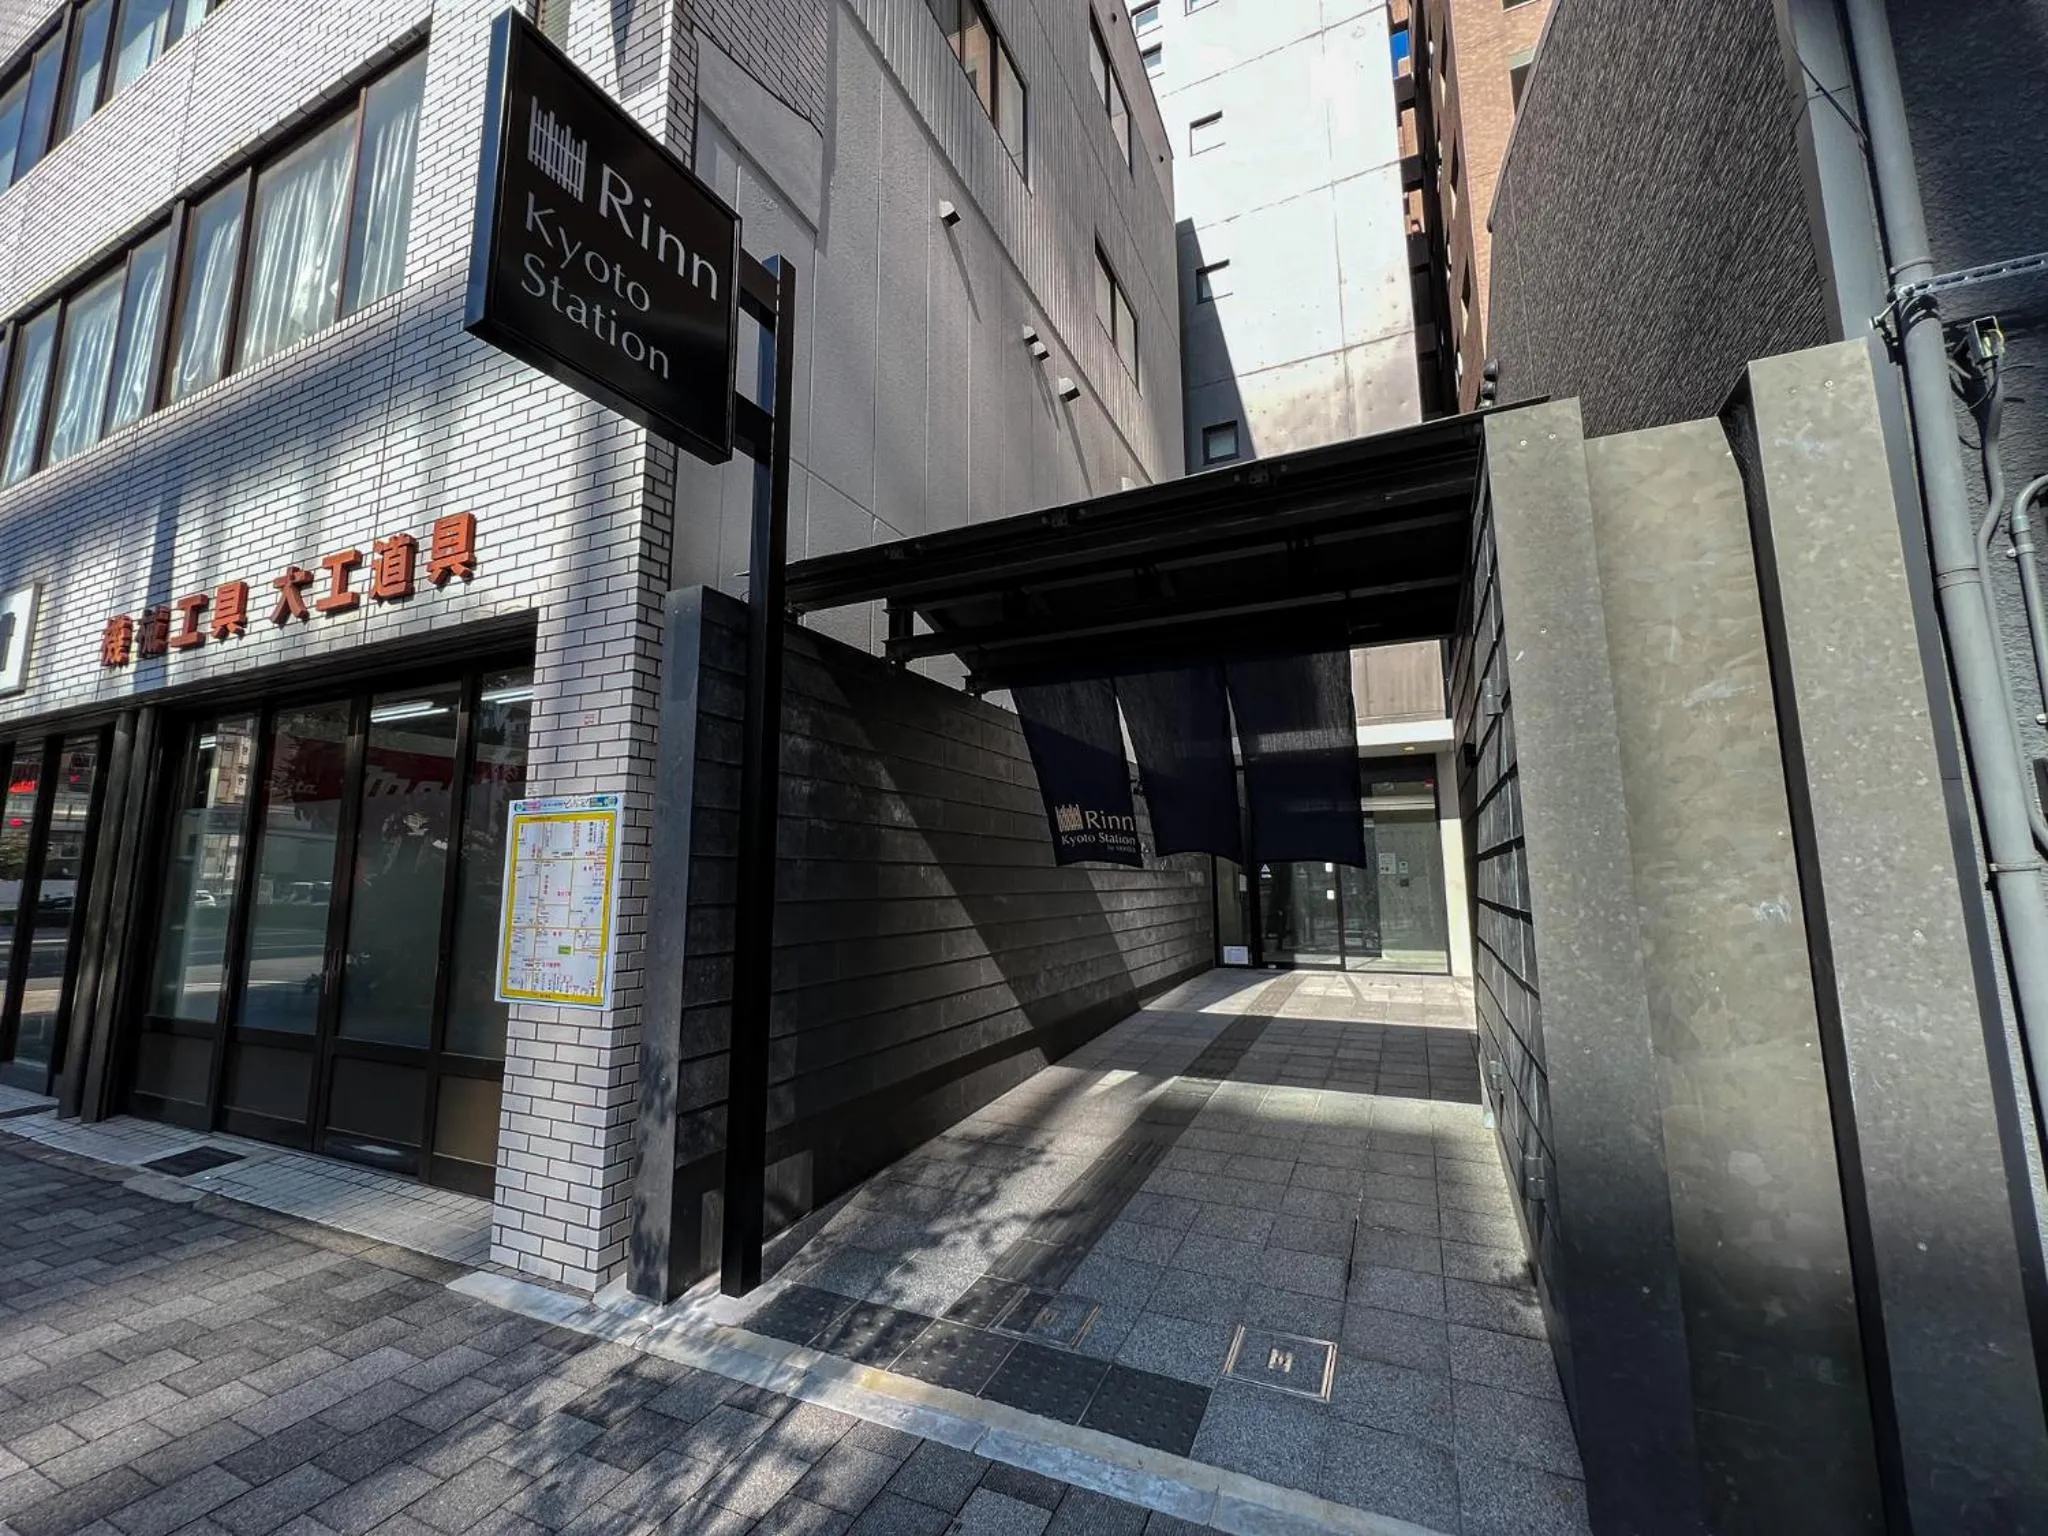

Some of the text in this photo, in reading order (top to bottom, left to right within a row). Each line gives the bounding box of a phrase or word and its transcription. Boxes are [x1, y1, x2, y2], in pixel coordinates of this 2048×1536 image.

[525, 190, 651, 313] Kyoto
[599, 162, 718, 301] Rinn
[521, 252, 669, 380] Station
[270, 511, 476, 628] 大工道具
[1061, 832, 1136, 847] Kyoto Station
[1085, 810, 1134, 831] Rinn
